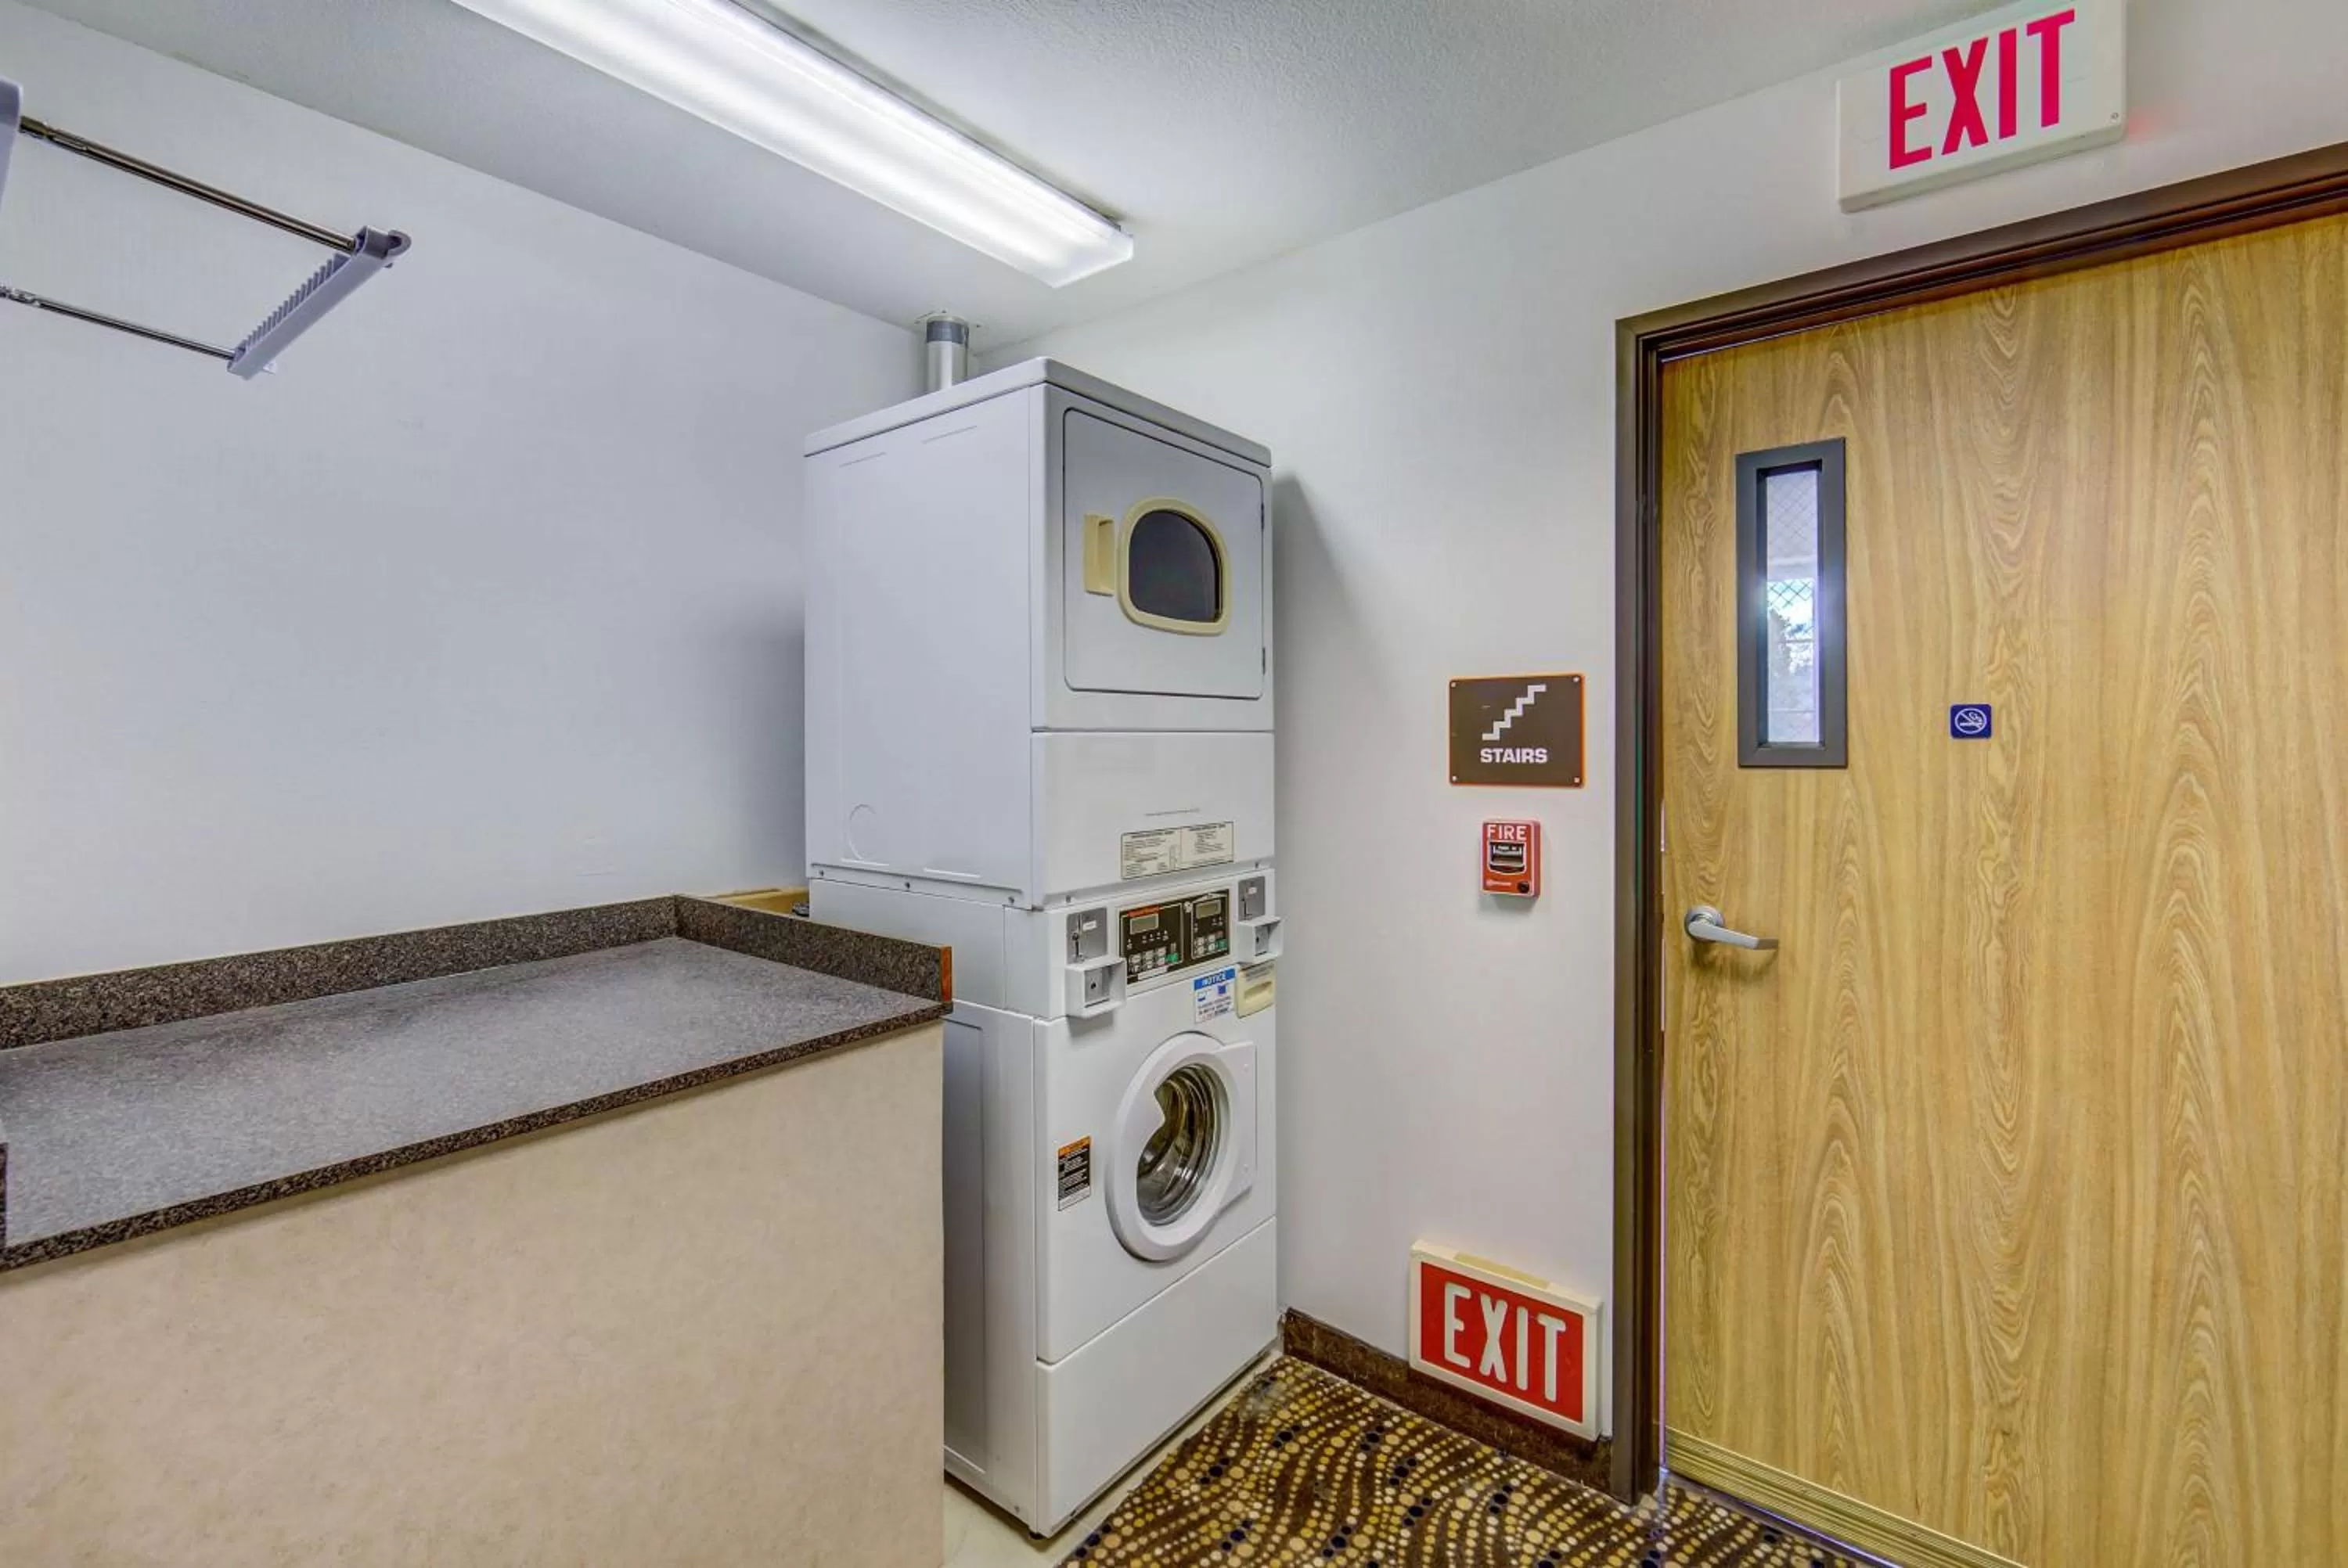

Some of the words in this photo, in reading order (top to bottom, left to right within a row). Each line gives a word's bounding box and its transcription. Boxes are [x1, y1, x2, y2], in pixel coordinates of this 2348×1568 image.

[1889, 9, 2075, 170] EXIT
[1480, 748, 1547, 764] STAIRS
[1488, 824, 1527, 840] FIRE
[1444, 1282, 1566, 1402] EXIT
